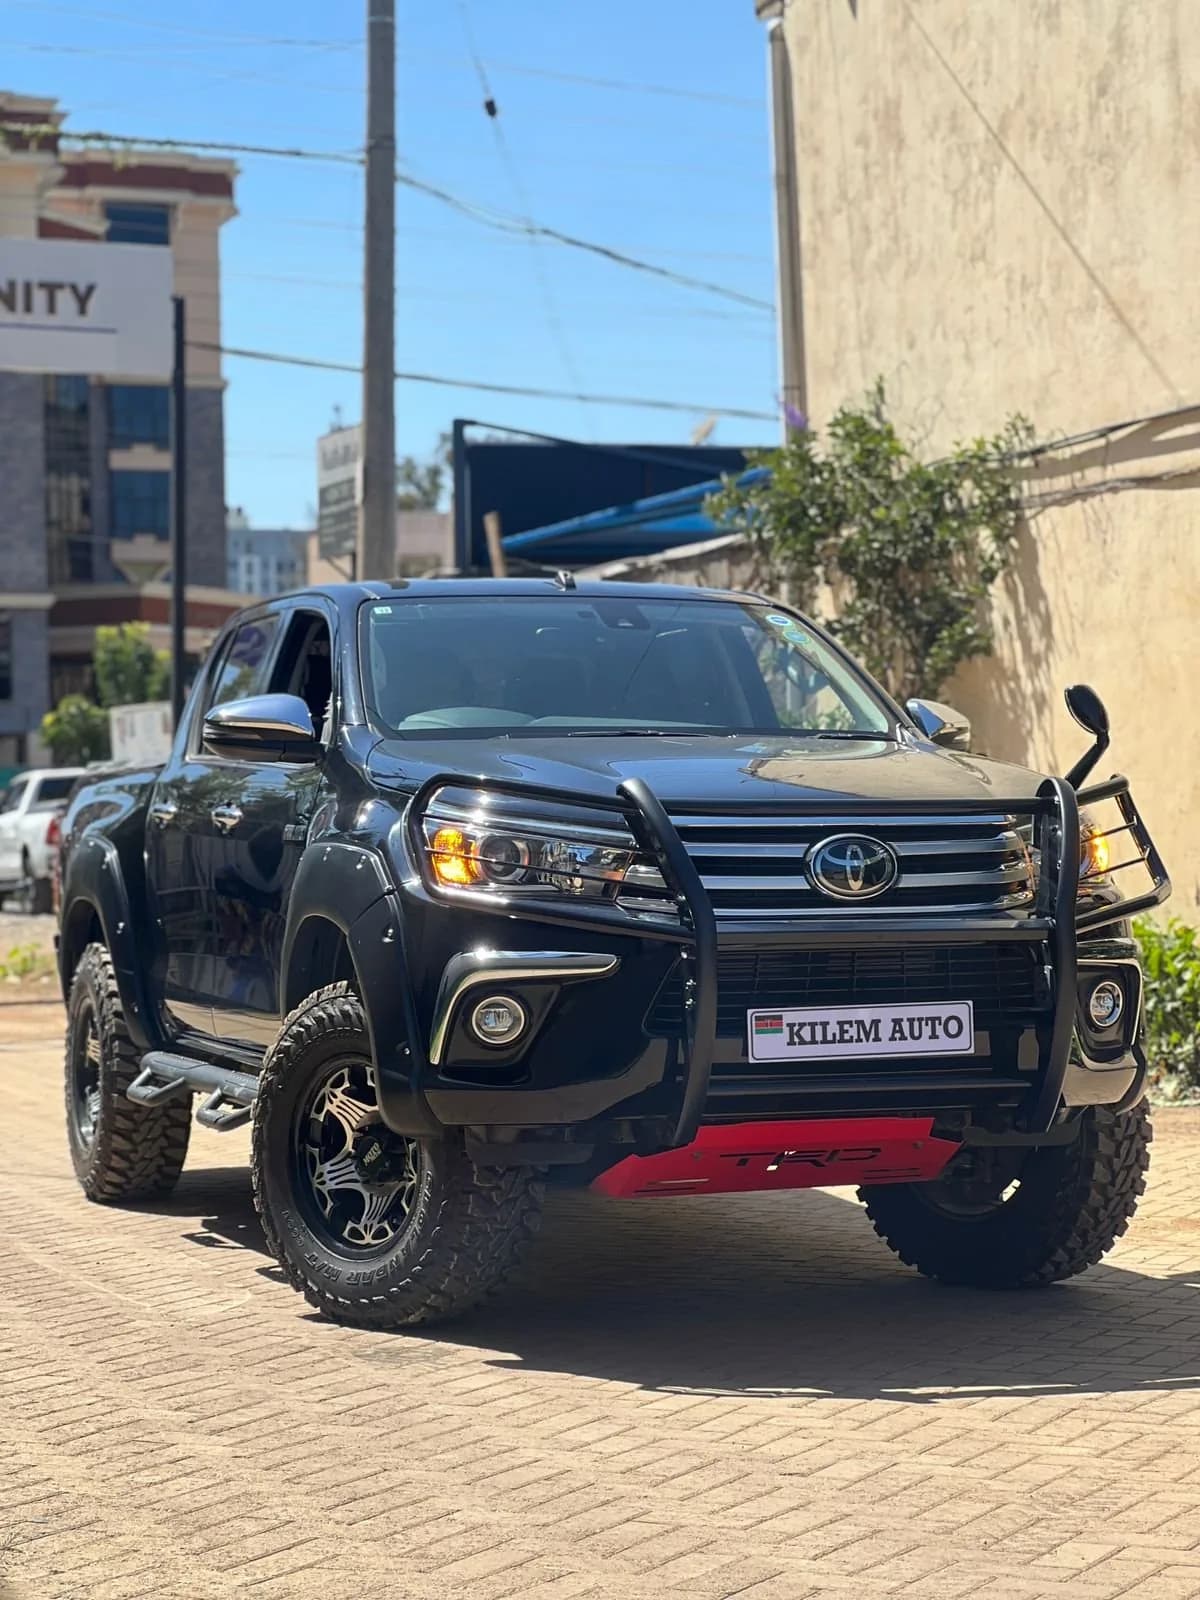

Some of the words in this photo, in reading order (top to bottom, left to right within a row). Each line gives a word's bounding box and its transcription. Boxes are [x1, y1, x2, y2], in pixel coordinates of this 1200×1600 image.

[786, 1018, 882, 1046] KILEM
[888, 1015, 964, 1042] AUTO
[719, 1147, 881, 1171] TRD
